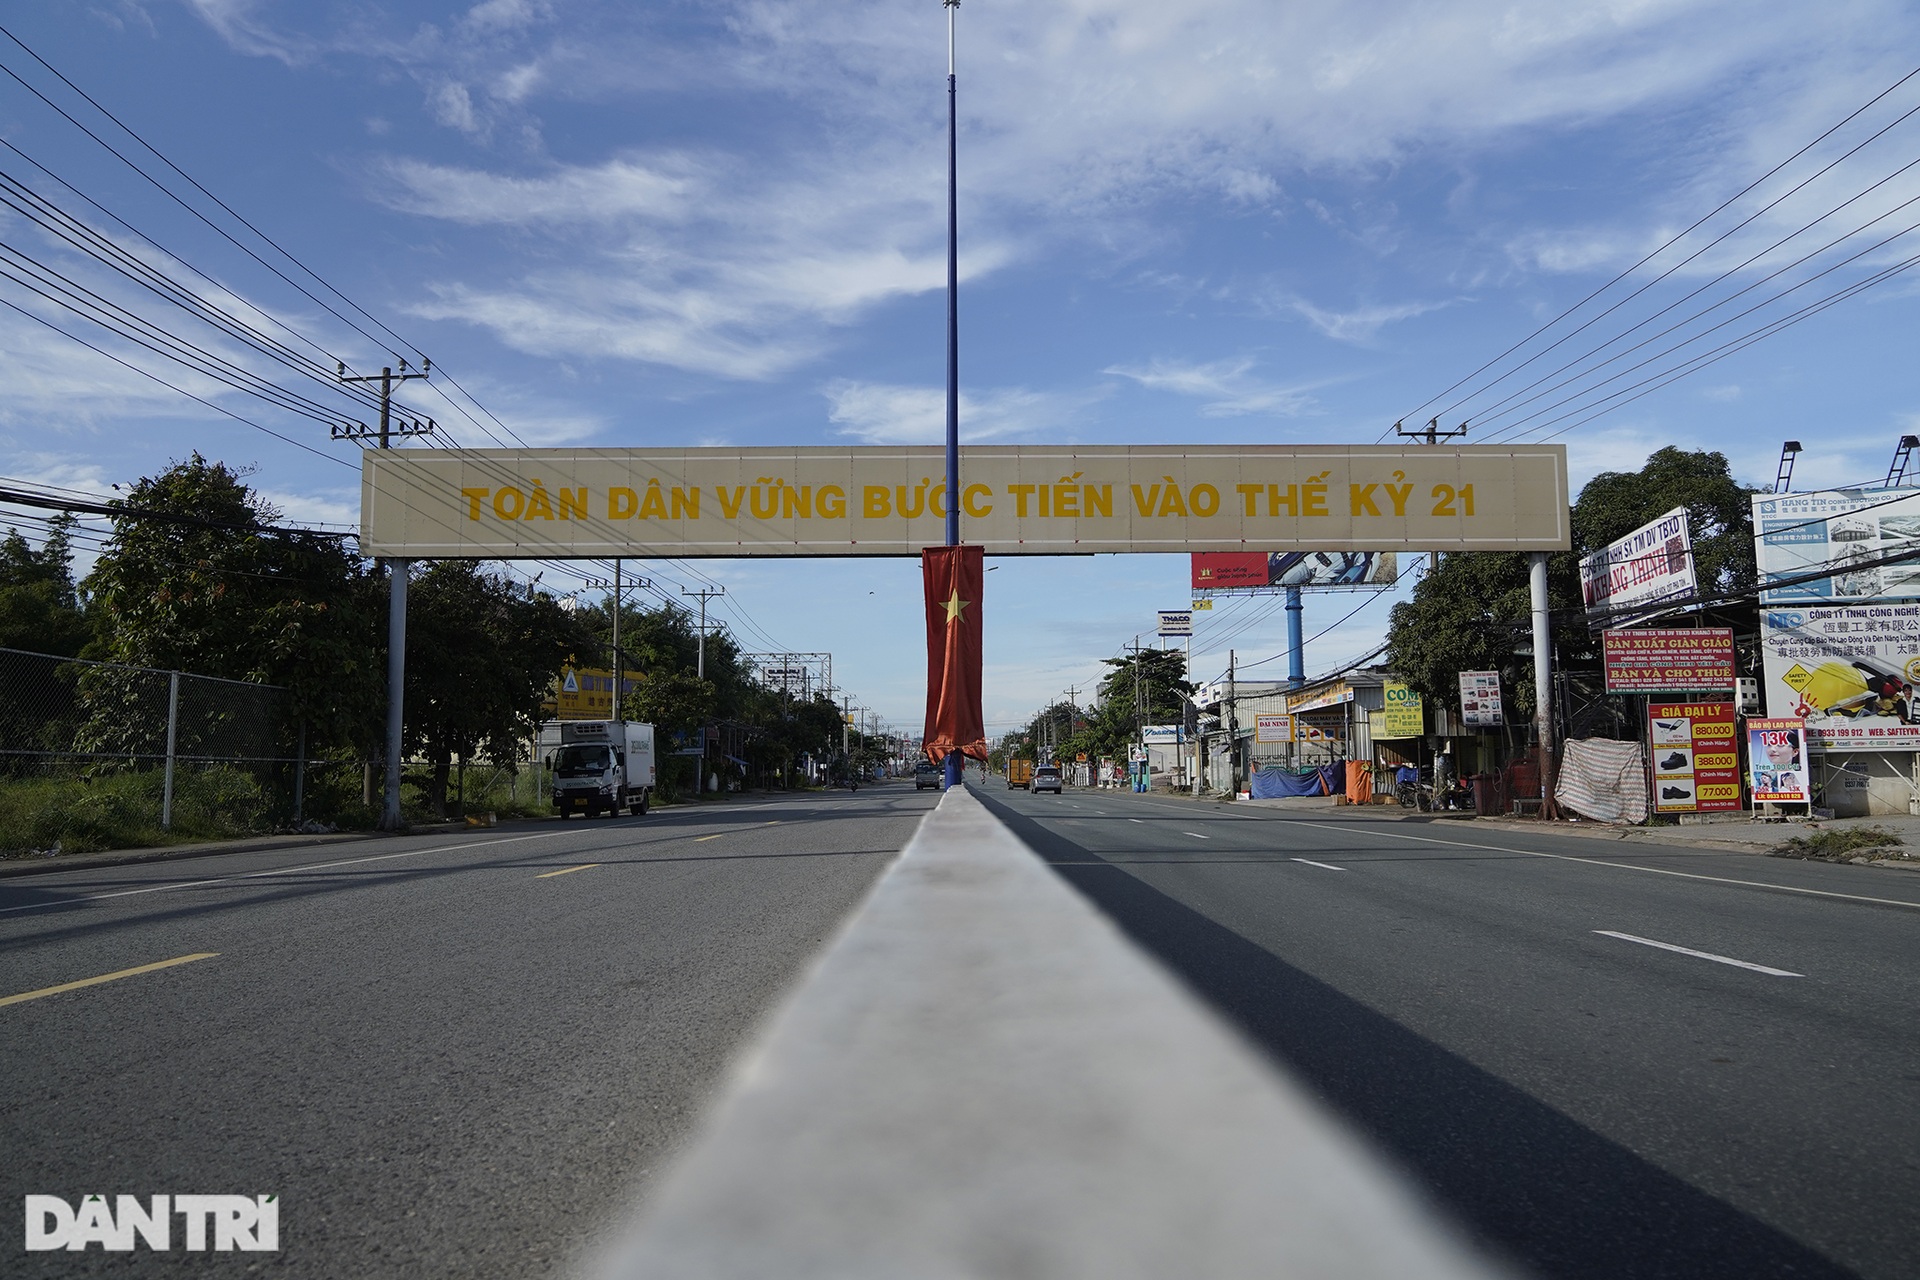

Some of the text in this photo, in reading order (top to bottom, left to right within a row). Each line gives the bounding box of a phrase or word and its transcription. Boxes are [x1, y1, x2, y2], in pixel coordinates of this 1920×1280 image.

[461, 470, 1475, 521] TOÀN DÂN VỮNG BƯỚC TIẾN VÀO THẾ KỶ 21
[1782, 499, 1809, 507] HANG
[1811, 498, 1827, 506] TIN
[1624, 539, 1634, 558] SX
[1634, 533, 1646, 553] TM
[1646, 527, 1658, 547] DV
[1658, 515, 1680, 541] TBXD
[1594, 564, 1629, 602] KHANG
[1810, 609, 1832, 619] CÔNG
[1834, 609, 1843, 619] TY
[1845, 609, 1867, 618] TNHH
[1870, 607, 1892, 618] CÔNG
[1606, 636, 1731, 649] SẢN XUẤT GIÀN GIÁO
[1611, 667, 1731, 678] BÁN VÀ CHO THUÊ
[1661, 704, 1721, 718] GIÁ ĐẠI LÝ
[1695, 725, 1731, 735] 880.000
[1749, 721, 1803, 730] BẢO HỘ LAO ĐỘNG
[1817, 729, 1835, 737] 0933
[1837, 729, 1850, 737] 199
[1850, 729, 1863, 737] 912
[1868, 728, 1886, 736] WEB:
[1760, 731, 1789, 746] 13K
[1698, 756, 1733, 766] 388.000
[1702, 787, 1733, 797] 77.000
